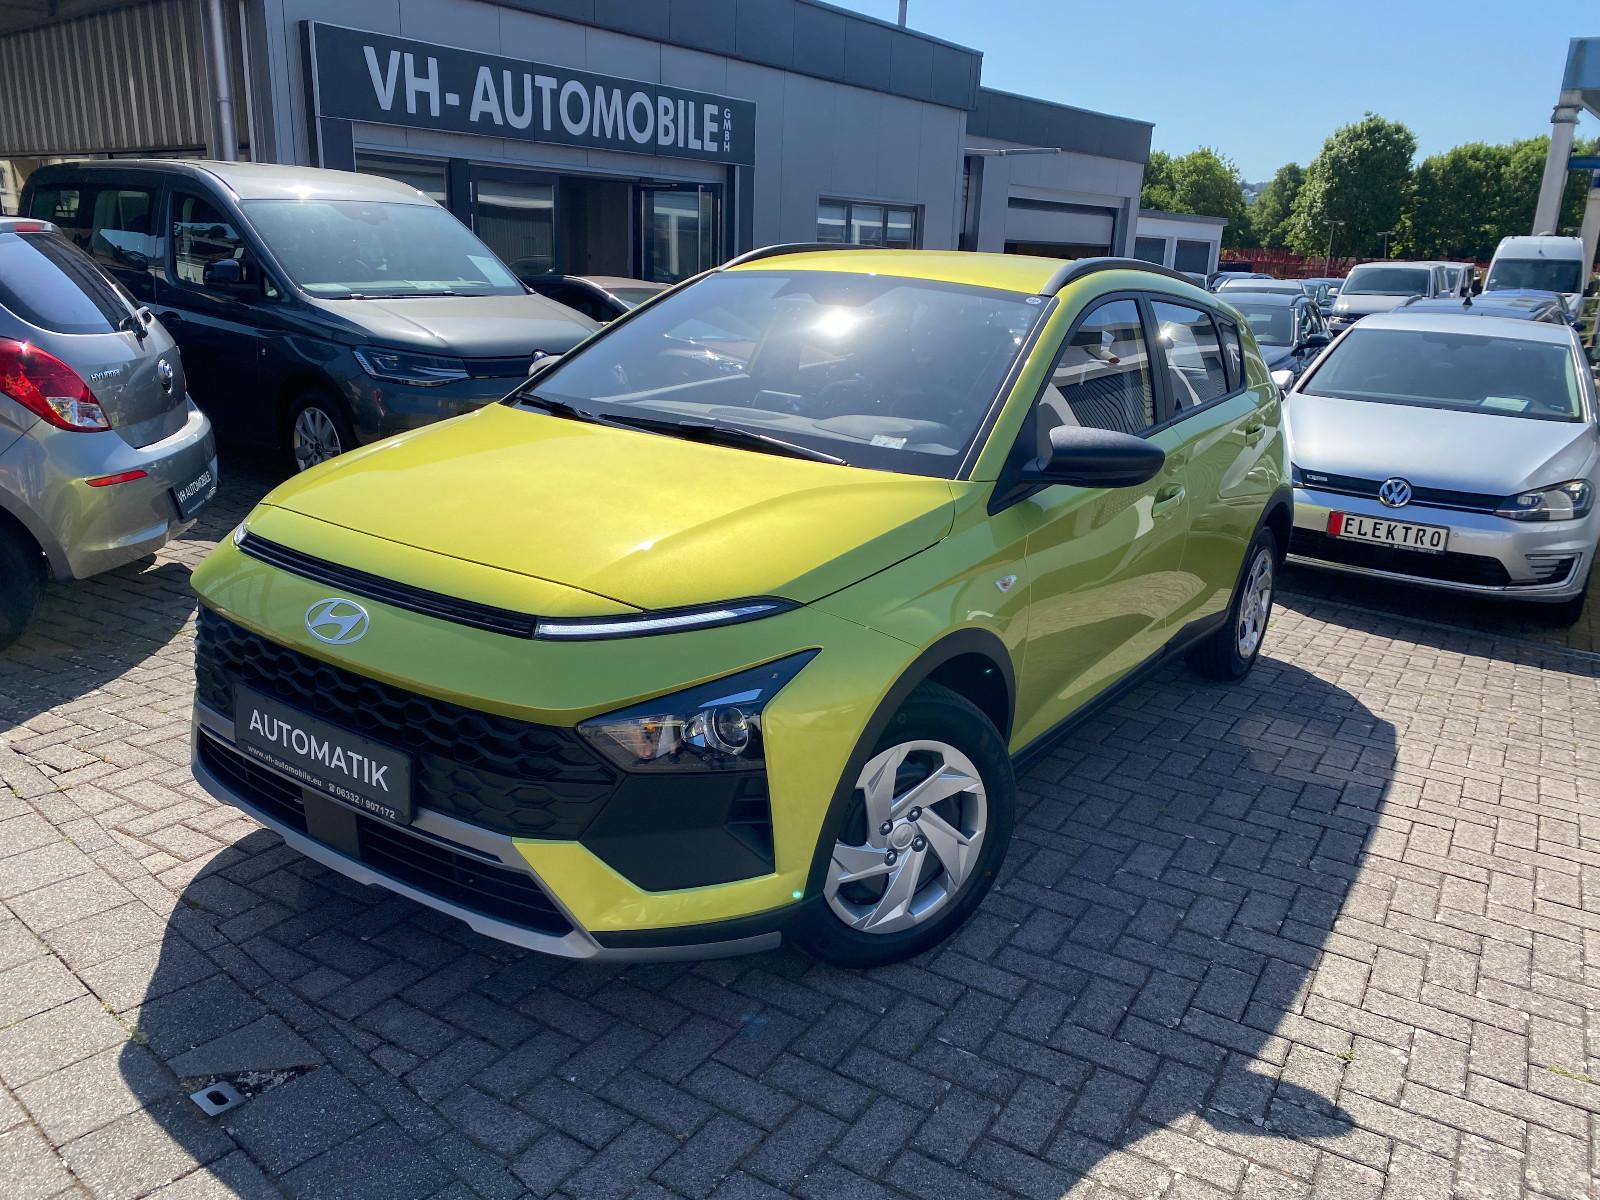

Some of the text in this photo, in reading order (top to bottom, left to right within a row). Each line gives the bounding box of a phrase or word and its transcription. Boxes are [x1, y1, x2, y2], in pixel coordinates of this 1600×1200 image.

[1344, 517, 1441, 547] ELEKTRO
[247, 744, 322, 787] www.vh-automobile.eu
[336, 787, 360, 804] 06332
[365, 799, 396, 820] 907172
[249, 709, 389, 792] AUTOMATIK
